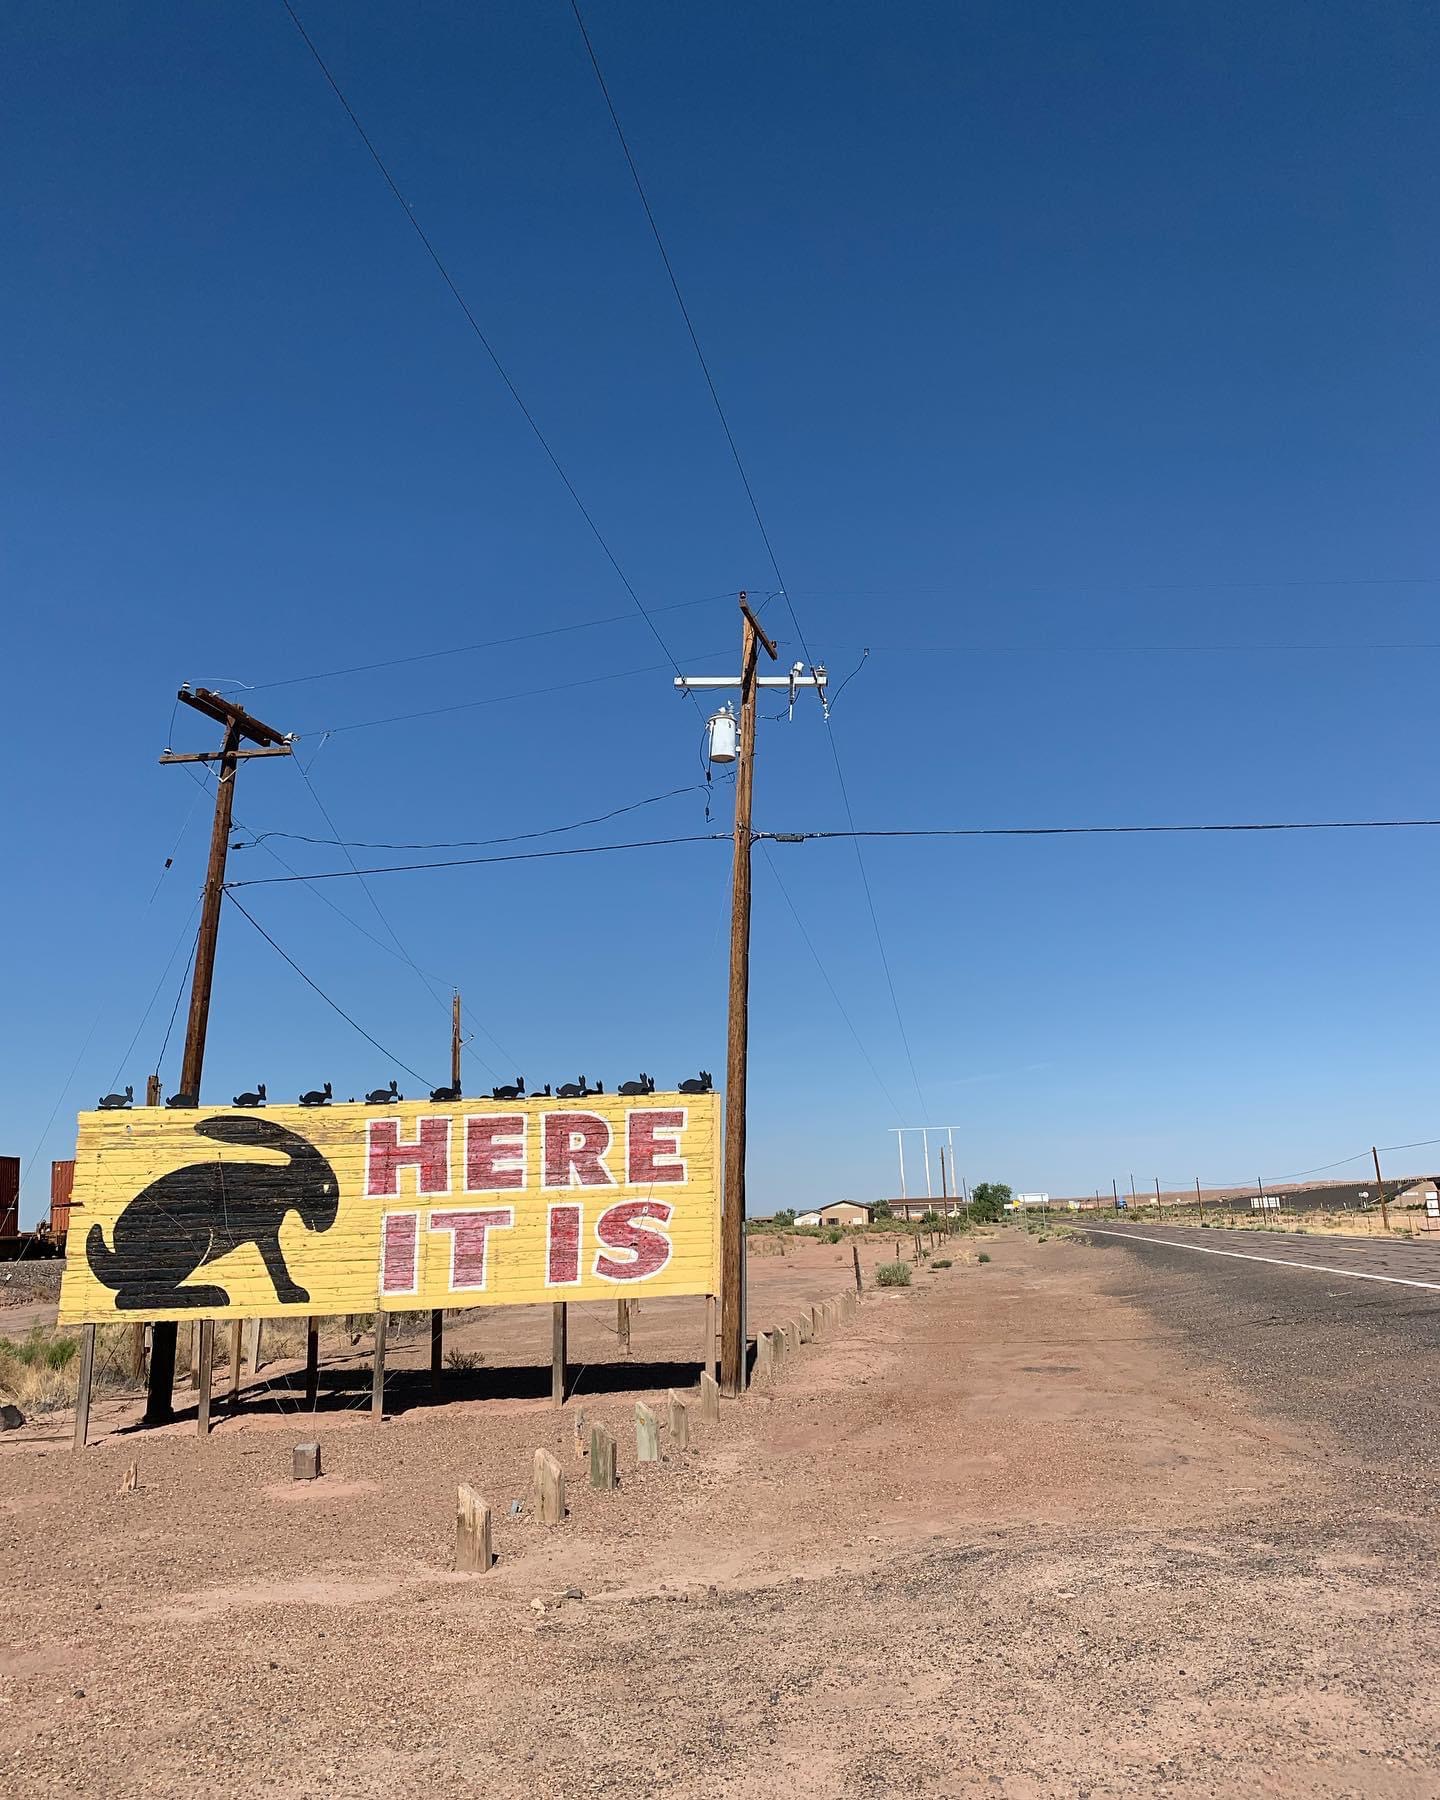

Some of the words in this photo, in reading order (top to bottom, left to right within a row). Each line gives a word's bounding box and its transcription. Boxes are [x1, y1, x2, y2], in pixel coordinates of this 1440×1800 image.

[364, 1109, 688, 1198] HERE
[381, 1208, 515, 1295] IT
[545, 1200, 675, 1286] IS
